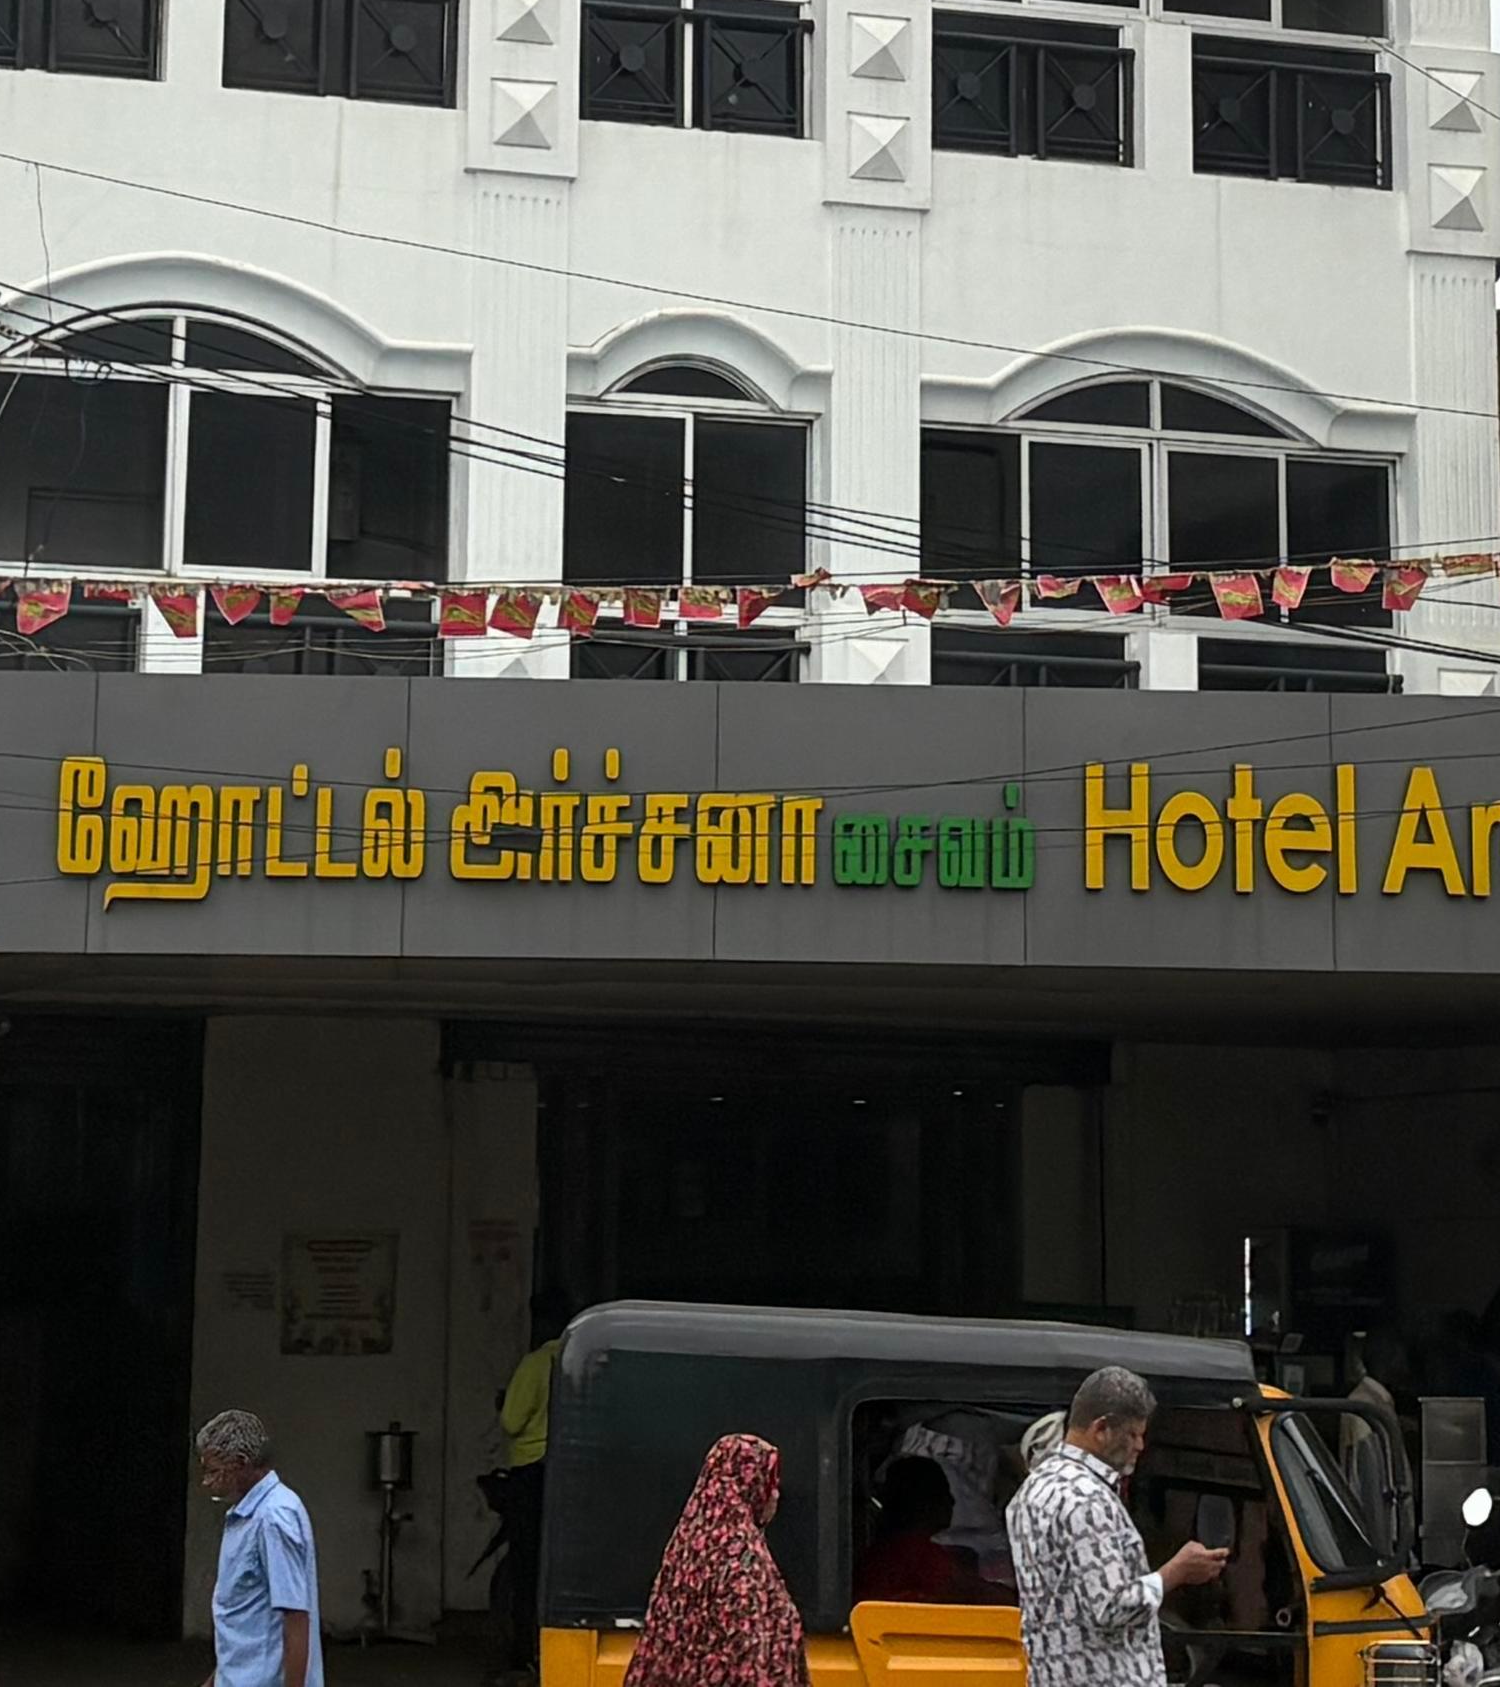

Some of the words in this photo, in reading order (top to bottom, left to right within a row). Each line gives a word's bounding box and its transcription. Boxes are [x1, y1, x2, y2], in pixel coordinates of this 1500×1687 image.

[56, 748, 426, 910] ஹோட்டல்
[449, 748, 823, 886] அர்ச்சனா
[833, 783, 1036, 891] சைவம்
[1083, 761, 1358, 897] Hotel
